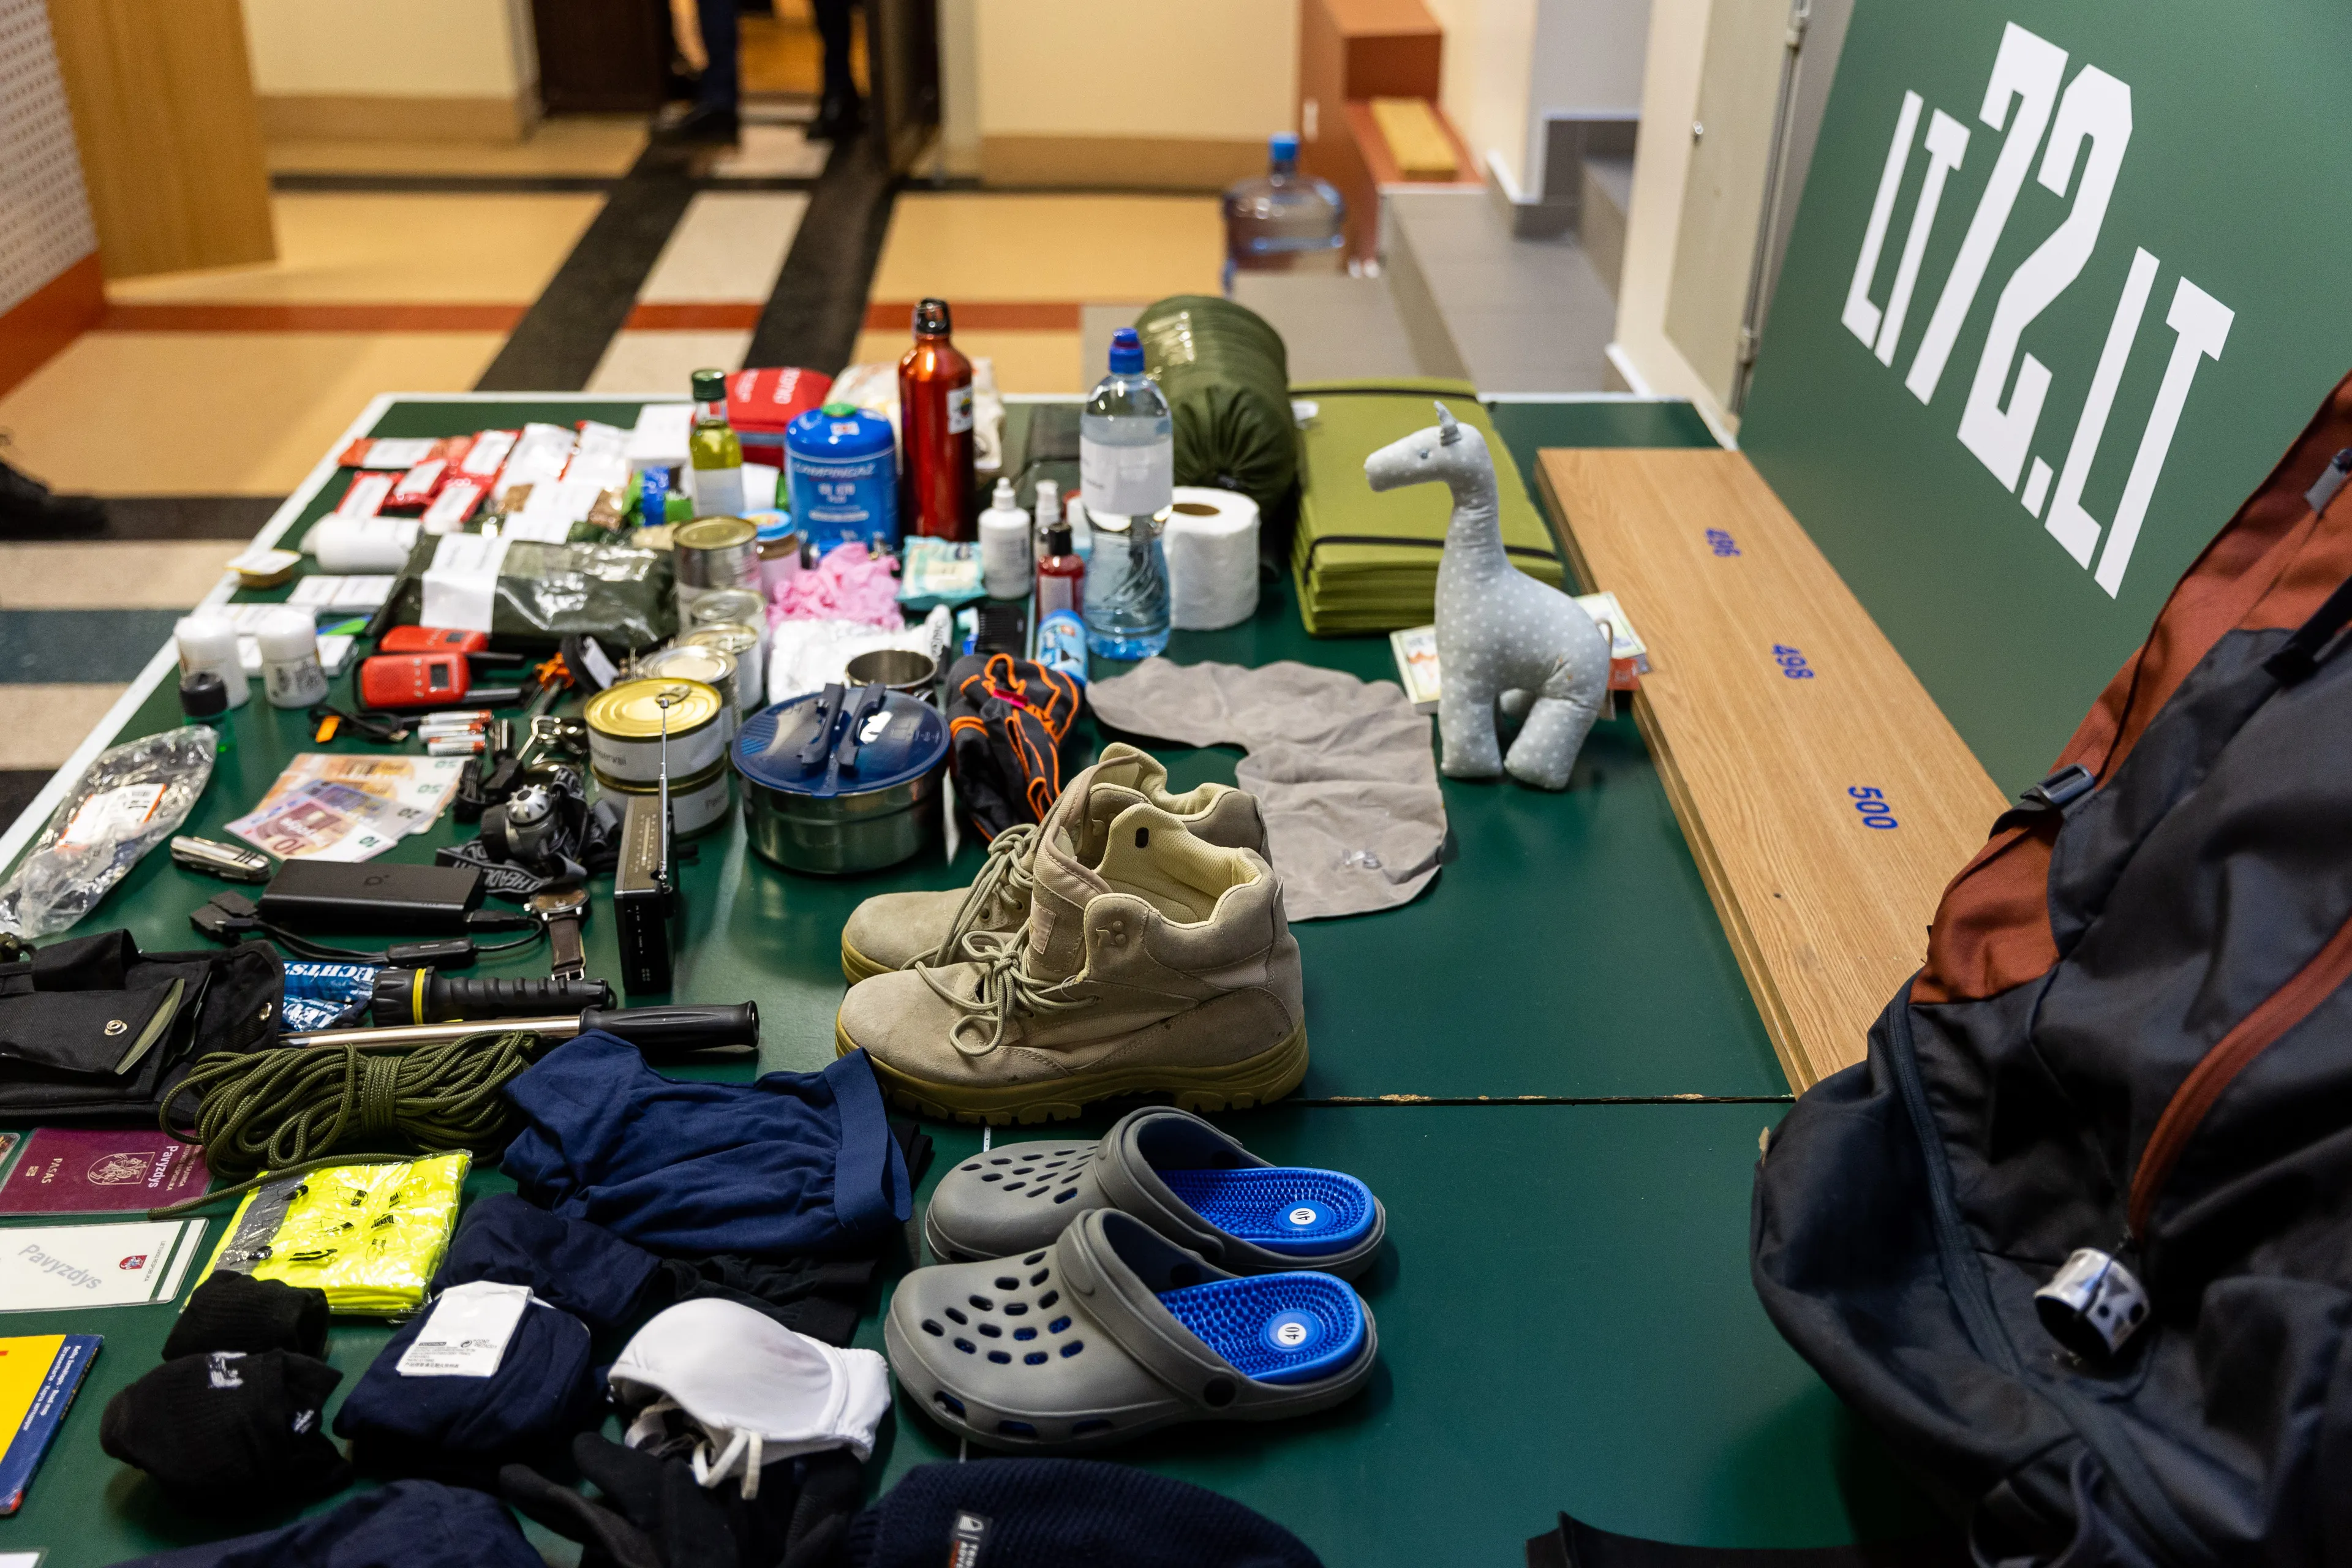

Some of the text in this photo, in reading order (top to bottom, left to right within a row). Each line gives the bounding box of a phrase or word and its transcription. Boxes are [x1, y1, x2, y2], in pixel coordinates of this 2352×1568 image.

[1772, 644, 1814, 679] 498
[1847, 786, 1898, 829] 500
[41, 1158, 63, 1184] PASAS
[148, 1145, 179, 1188] Pavyzdys
[1295, 1210, 1310, 1221] 40
[18, 1243, 102, 1289] Pavyzdys
[1285, 1326, 1300, 1340] 40
